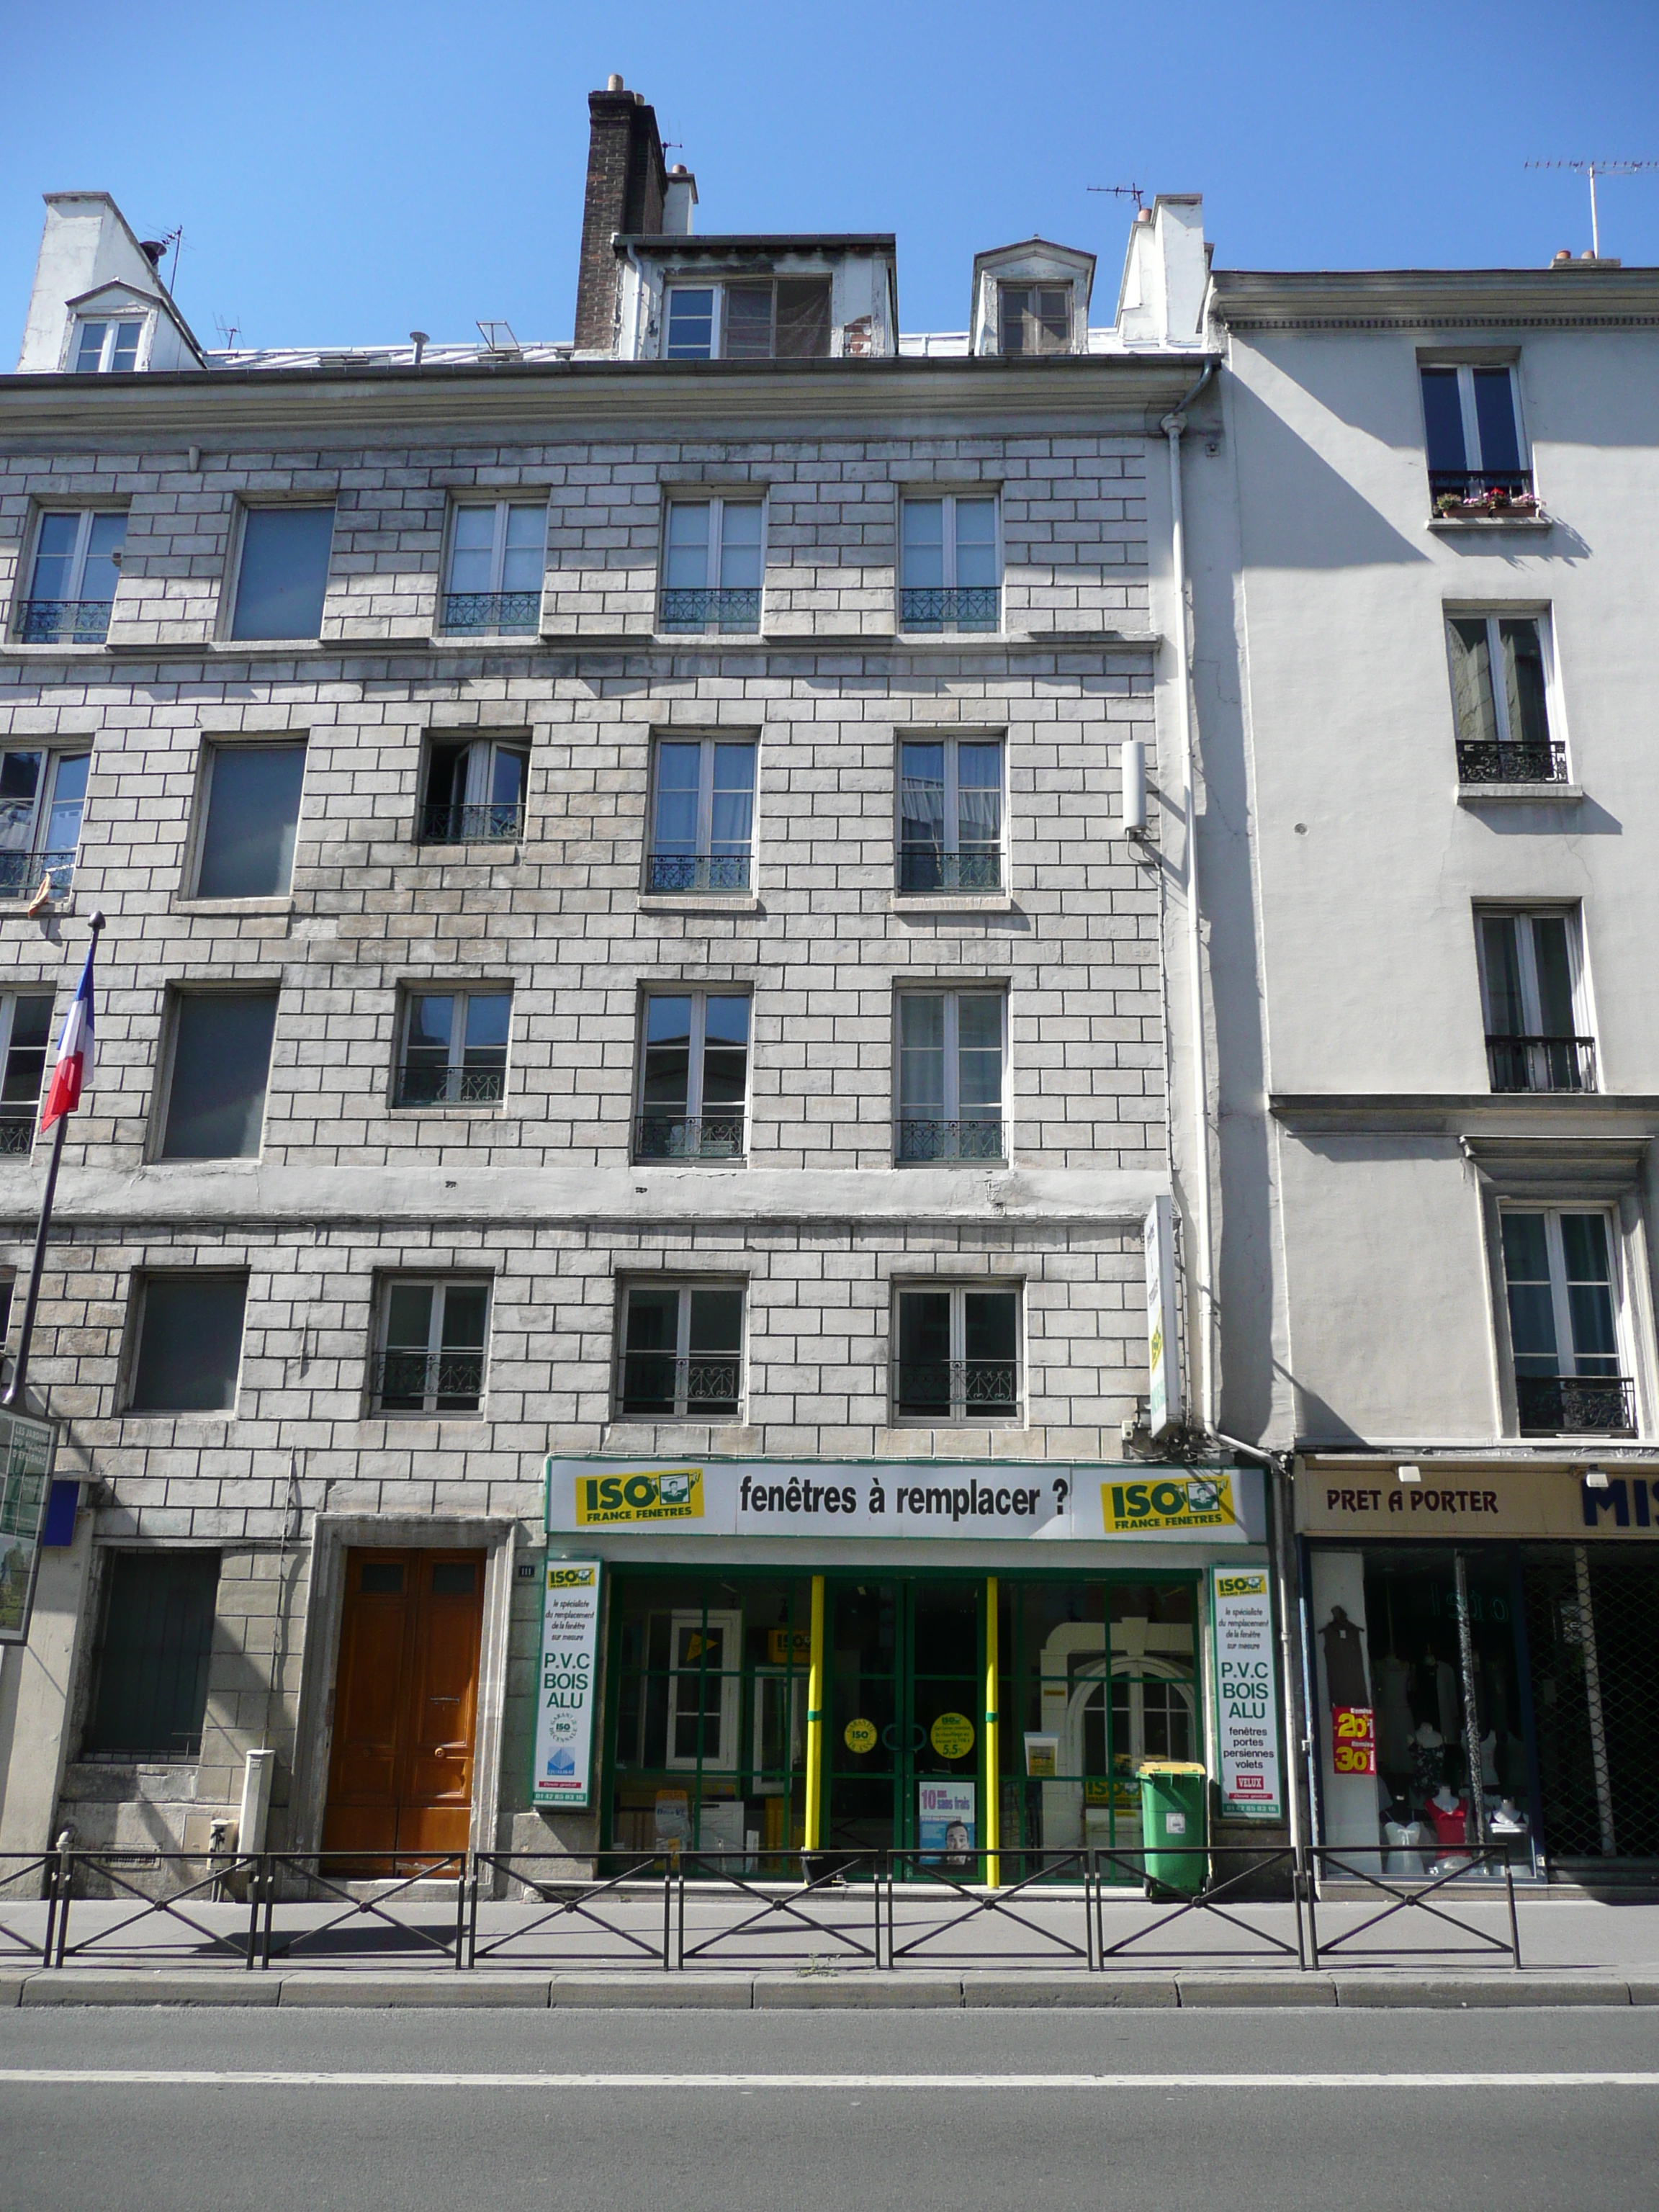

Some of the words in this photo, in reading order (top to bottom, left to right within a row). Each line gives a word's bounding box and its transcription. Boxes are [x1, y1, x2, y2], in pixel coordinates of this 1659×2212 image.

[15, 1425, 25, 1436] LES
[26, 1428, 50, 1443] JARDINS
[14, 1437, 22, 1447] DU
[586, 1475, 656, 1511] ISO
[739, 1475, 857, 1514] fenêtres
[869, 1478, 885, 1514] à
[896, 1479, 1040, 1522] remplacer
[1111, 1482, 1185, 1519] ISO
[1326, 1489, 1382, 1513] PRET
[1388, 1490, 1403, 1512] A
[1410, 1490, 1499, 1514] PORTER
[1581, 1479, 1659, 1527] MI
[587, 1510, 632, 1522] FRANCE
[636, 1506, 693, 1519] FENETRES
[1114, 1518, 1161, 1530] FRANCE
[1165, 1514, 1223, 1527] FENETRES
[549, 1570, 577, 1584] ISO
[1218, 1578, 1247, 1592] ISO
[559, 1599, 590, 1610] spécialiste
[545, 1610, 553, 1619] du
[554, 1610, 595, 1620] remplacement
[1232, 1607, 1263, 1617] spécialiste
[551, 1621, 559, 1629] de
[565, 1622, 585, 1630] fenêtre
[1218, 1618, 1226, 1627] du
[1227, 1618, 1269, 1629] remplacement
[1226, 1629, 1233, 1638] de
[1240, 1629, 1261, 1638] fenêtre
[544, 1653, 590, 1670] P.V.C
[1220, 1662, 1269, 1678] P.V.C
[544, 1673, 588, 1690] BOIS
[1223, 1682, 1269, 1699] BOIS
[546, 1692, 583, 1709] ALU
[1228, 1702, 1266, 1719] ALU
[852, 1730, 869, 1739] ISO
[1229, 1727, 1268, 1736] fenêtres
[1233, 1738, 1264, 1748] portes
[1223, 1749, 1274, 1758] persiennes
[1235, 1760, 1263, 1769] volets
[1238, 1777, 1262, 1788] VELUX
[922, 1789, 936, 1810] 10
[937, 1799, 953, 1809] sans
[954, 1797, 970, 1810] frais
